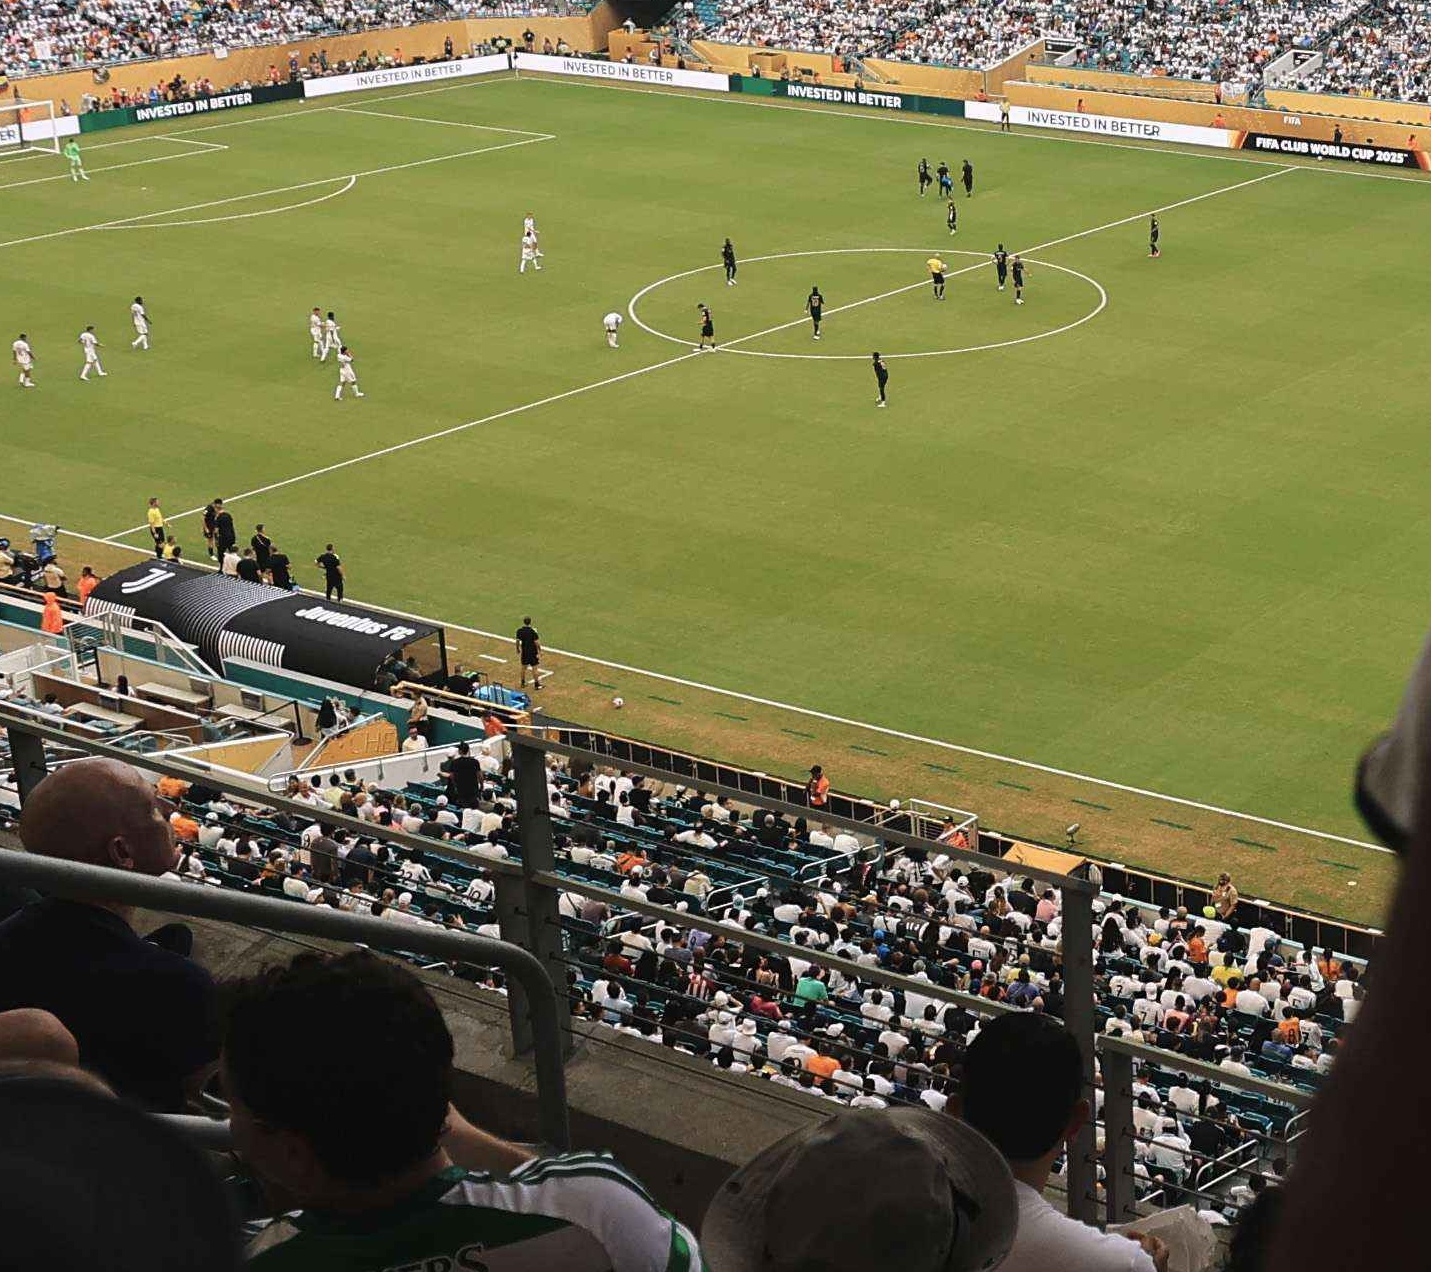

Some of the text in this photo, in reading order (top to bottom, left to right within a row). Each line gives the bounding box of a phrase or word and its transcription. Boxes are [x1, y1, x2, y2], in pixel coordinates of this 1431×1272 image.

[357, 63, 462, 86] INVESTED IN BETTER
[563, 61, 673, 81] INVESTED IN BETTER
[137, 93, 252, 120] INVESTED IN BETTER
[788, 85, 901, 108] INVESTED IN BETTER
[1028, 111, 1160, 137] INVESTED IN BETTER
[1284, 116, 1301, 125] FIFA
[1256, 137, 1279, 149] FIFA
[1280, 140, 1308, 153] CLUB
[1310, 143, 1350, 158] WORLD
[1352, 148, 1374, 159] CUP
[296, 607, 415, 641] Juventus FC
